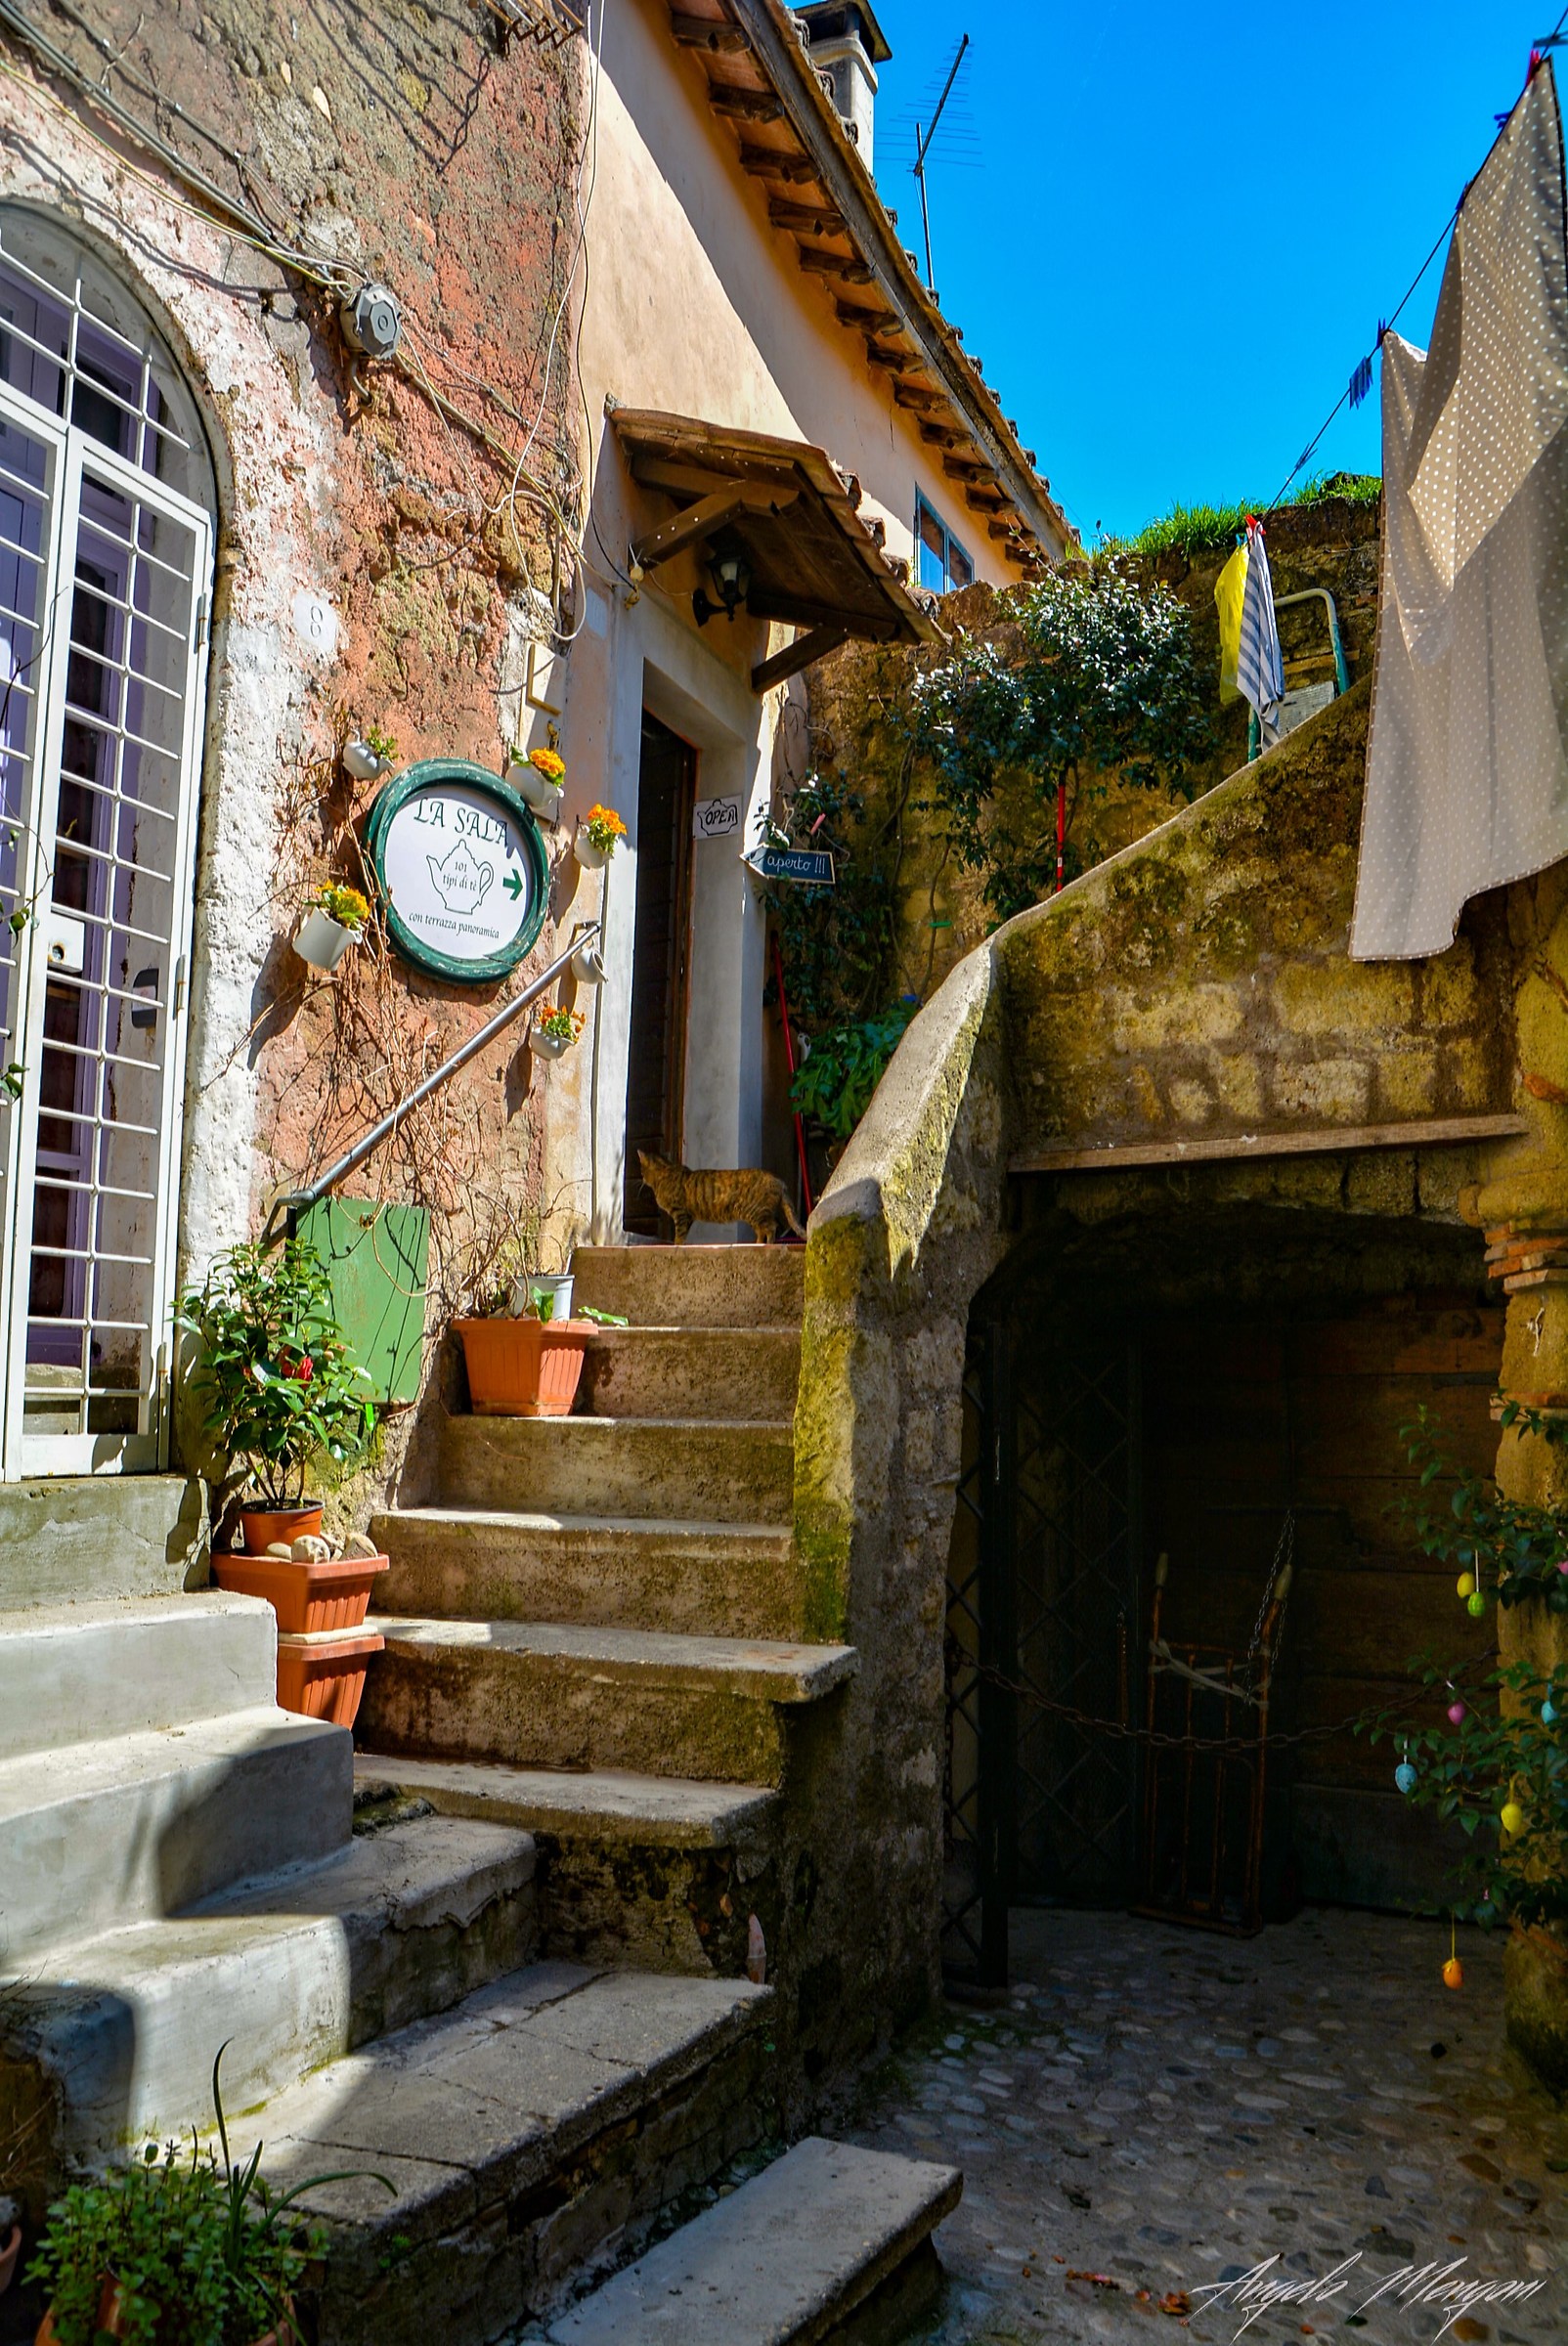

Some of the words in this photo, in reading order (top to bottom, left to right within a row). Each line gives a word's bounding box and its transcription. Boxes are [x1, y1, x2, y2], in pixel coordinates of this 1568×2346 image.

[310, 605, 324, 638] 8
[414, 797, 446, 828] LA
[455, 807, 508, 848] SALA
[705, 809, 734, 825] OPEN
[455, 861, 467, 873] 101
[766, 855, 811, 873] aperto
[443, 874, 457, 891] tipi
[459, 875, 468, 890] di
[409, 912, 423, 924] con
[424, 914, 457, 930] terrazza
[457, 922, 500, 939] panoramica
